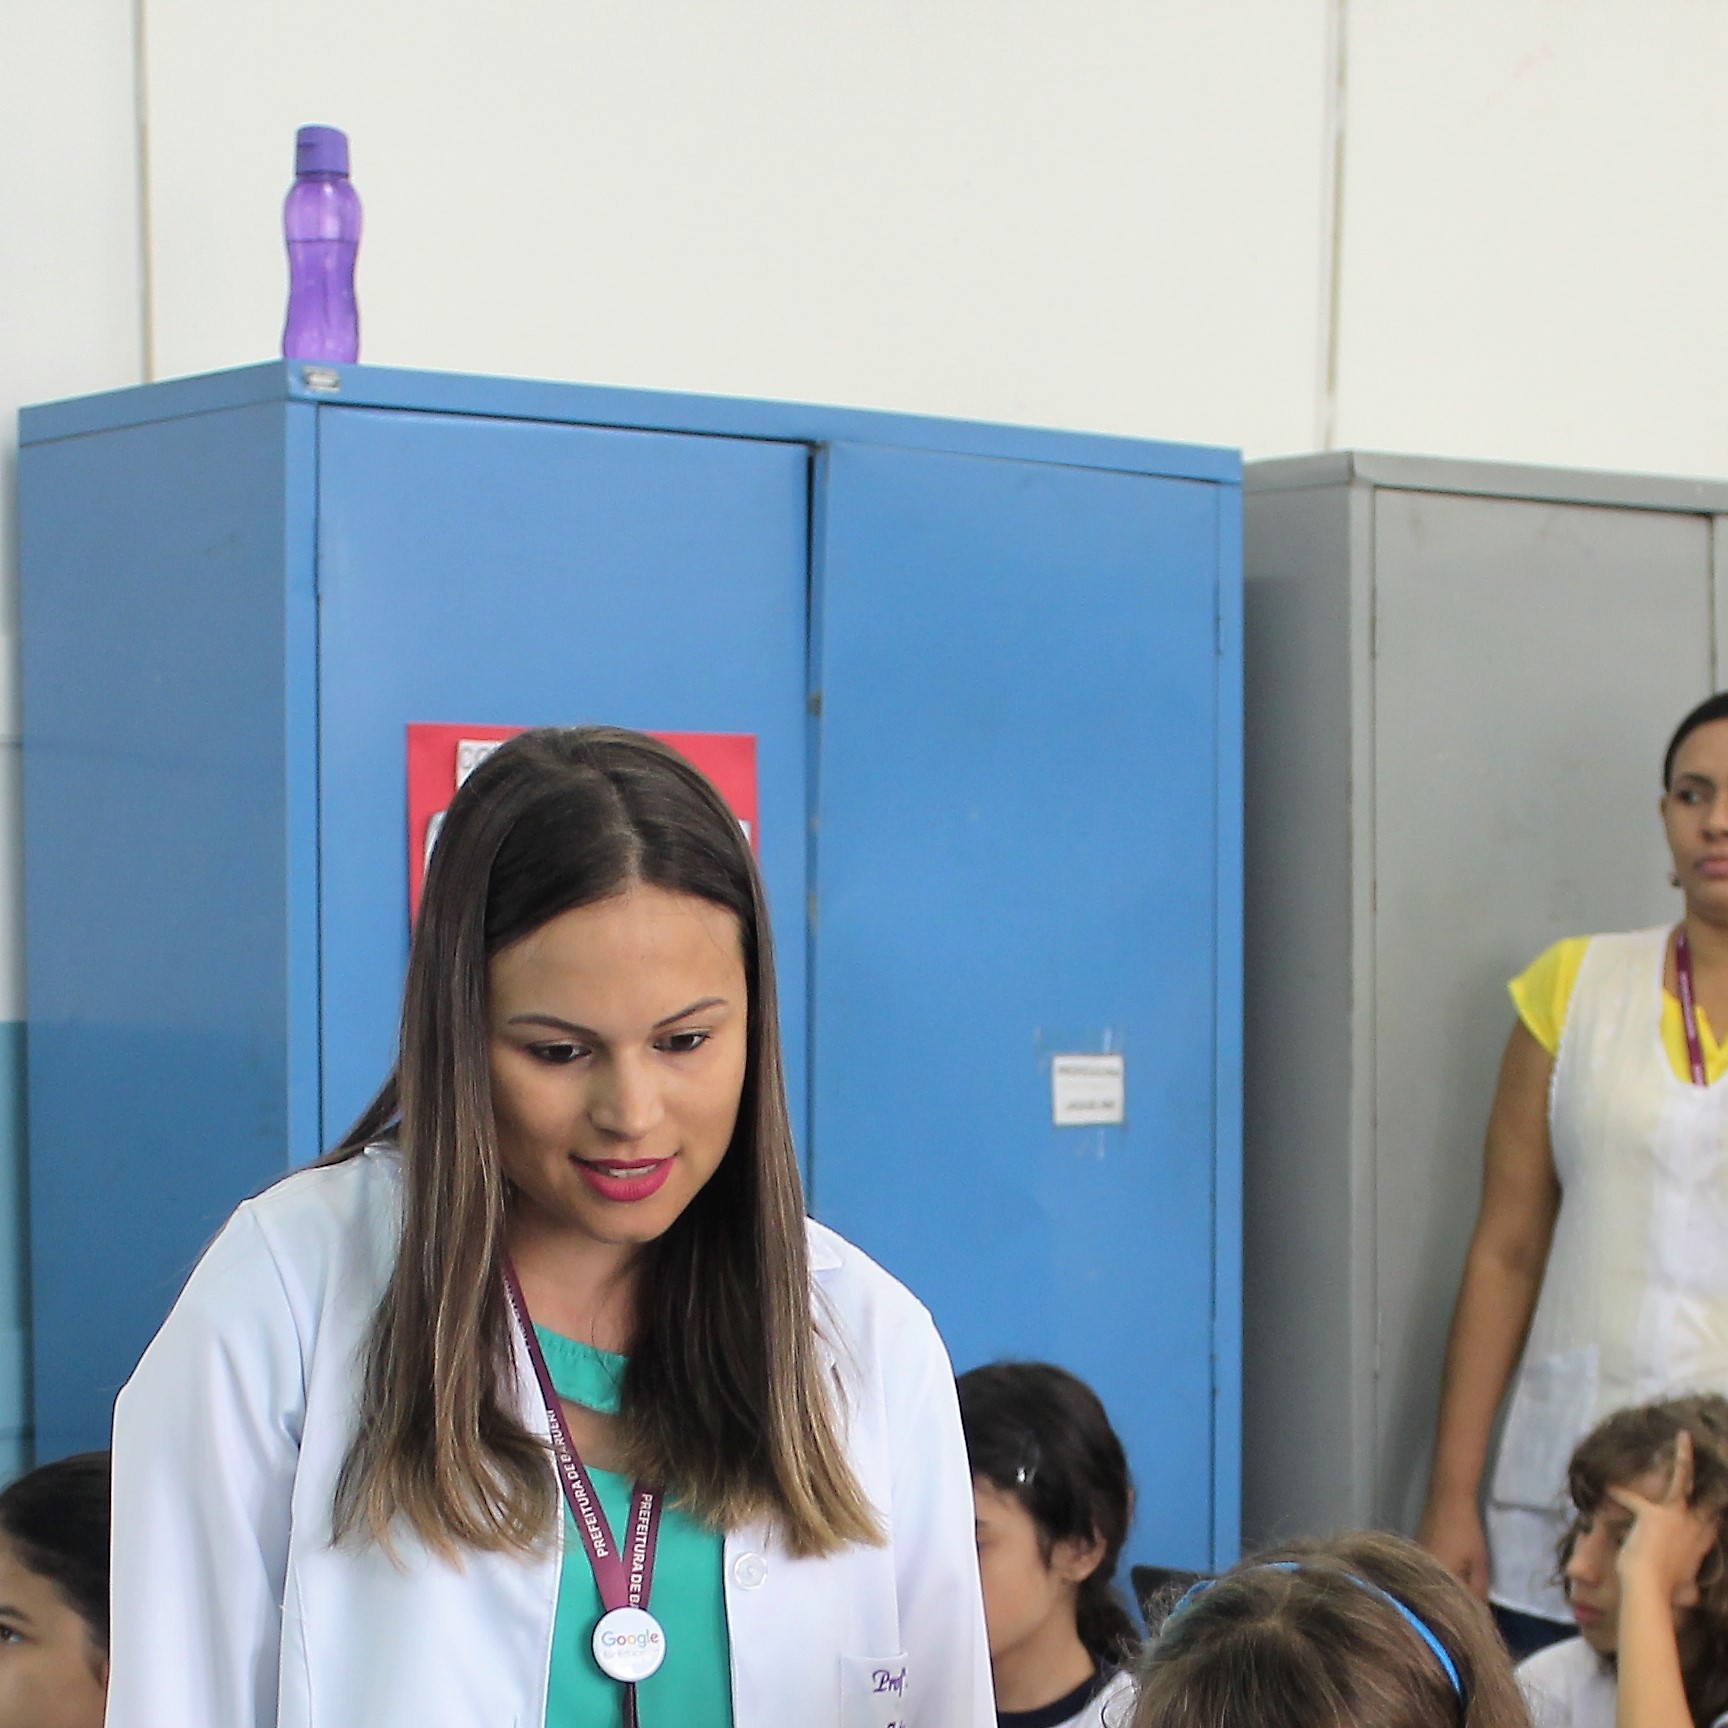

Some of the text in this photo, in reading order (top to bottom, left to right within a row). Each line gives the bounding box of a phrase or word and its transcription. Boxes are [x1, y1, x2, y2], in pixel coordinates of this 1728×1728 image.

[564, 1462, 580, 1481] DE
[570, 1478, 609, 1558] PREFEITURA
[631, 1493, 653, 1572] PREFEITURA
[630, 1573, 643, 1593] DE
[601, 1628, 659, 1648] Google
